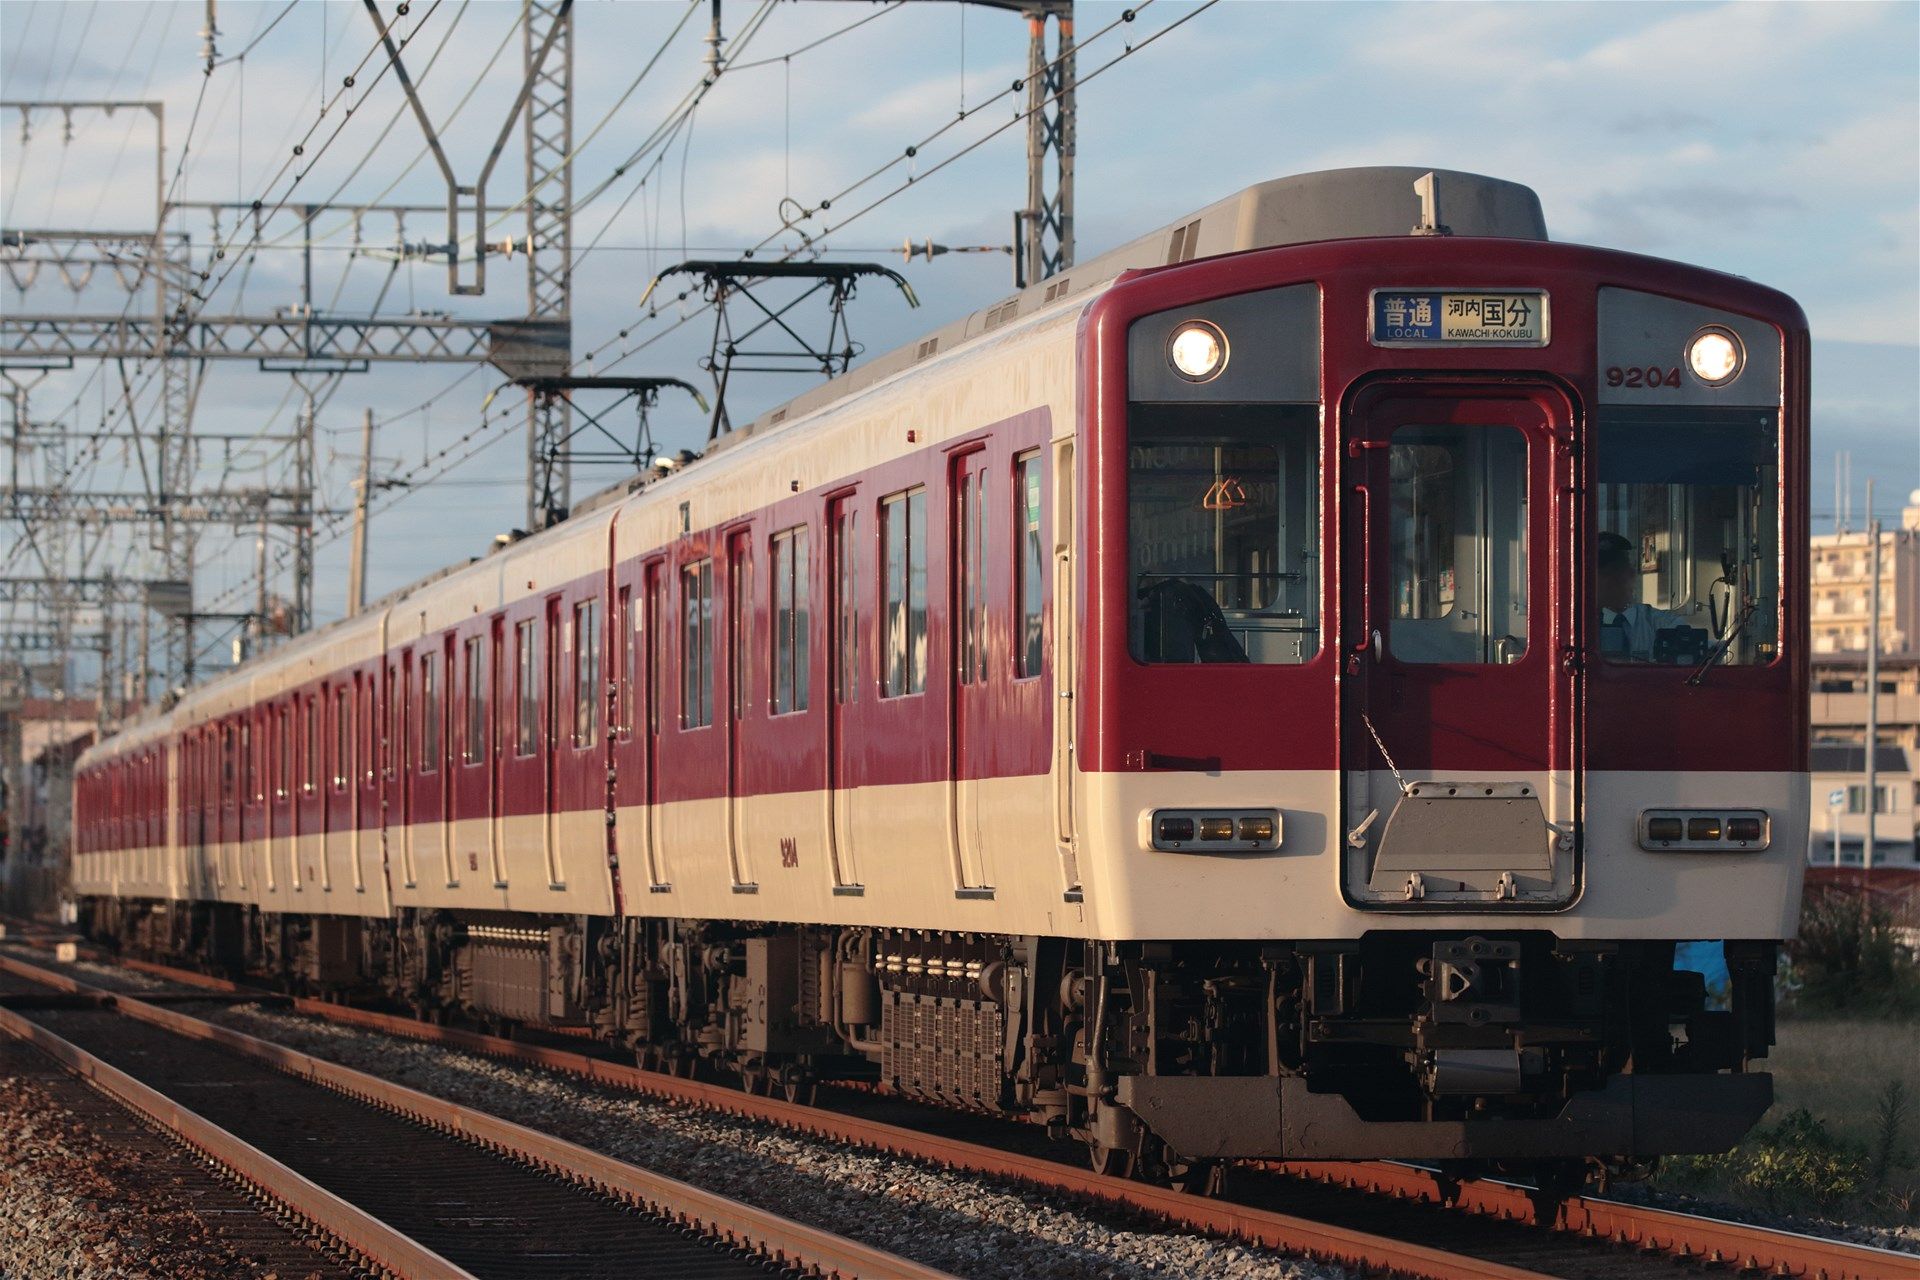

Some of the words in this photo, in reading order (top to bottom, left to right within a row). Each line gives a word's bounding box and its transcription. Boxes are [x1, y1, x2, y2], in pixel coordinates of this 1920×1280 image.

[1384, 298, 1432, 327] 普通
[1448, 298, 1531, 327] 河内国分
[1387, 329, 1429, 338] LOCAL
[1606, 366, 1681, 388] 9204
